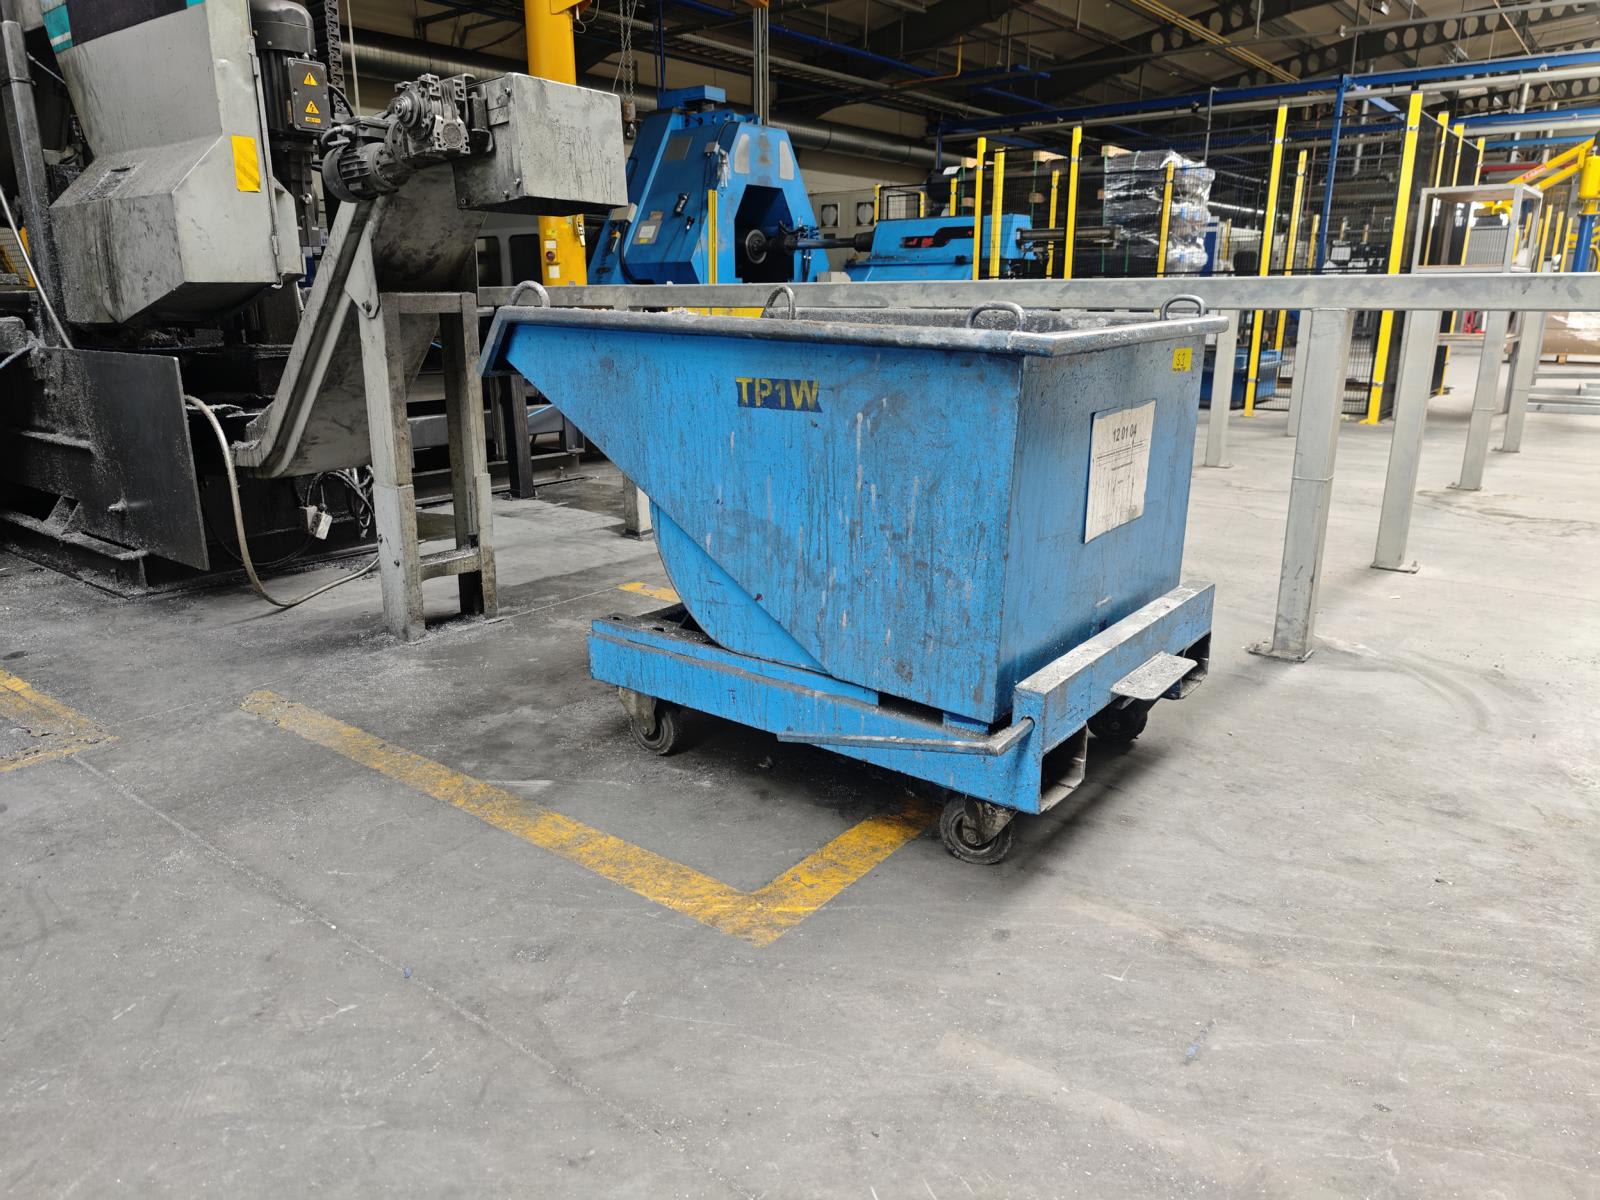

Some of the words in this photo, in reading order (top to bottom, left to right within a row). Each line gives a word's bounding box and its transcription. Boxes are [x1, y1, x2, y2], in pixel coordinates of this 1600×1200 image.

[735, 376, 818, 409] TP1W
[1113, 427, 1120, 442] 12
[1121, 426, 1129, 441] 01
